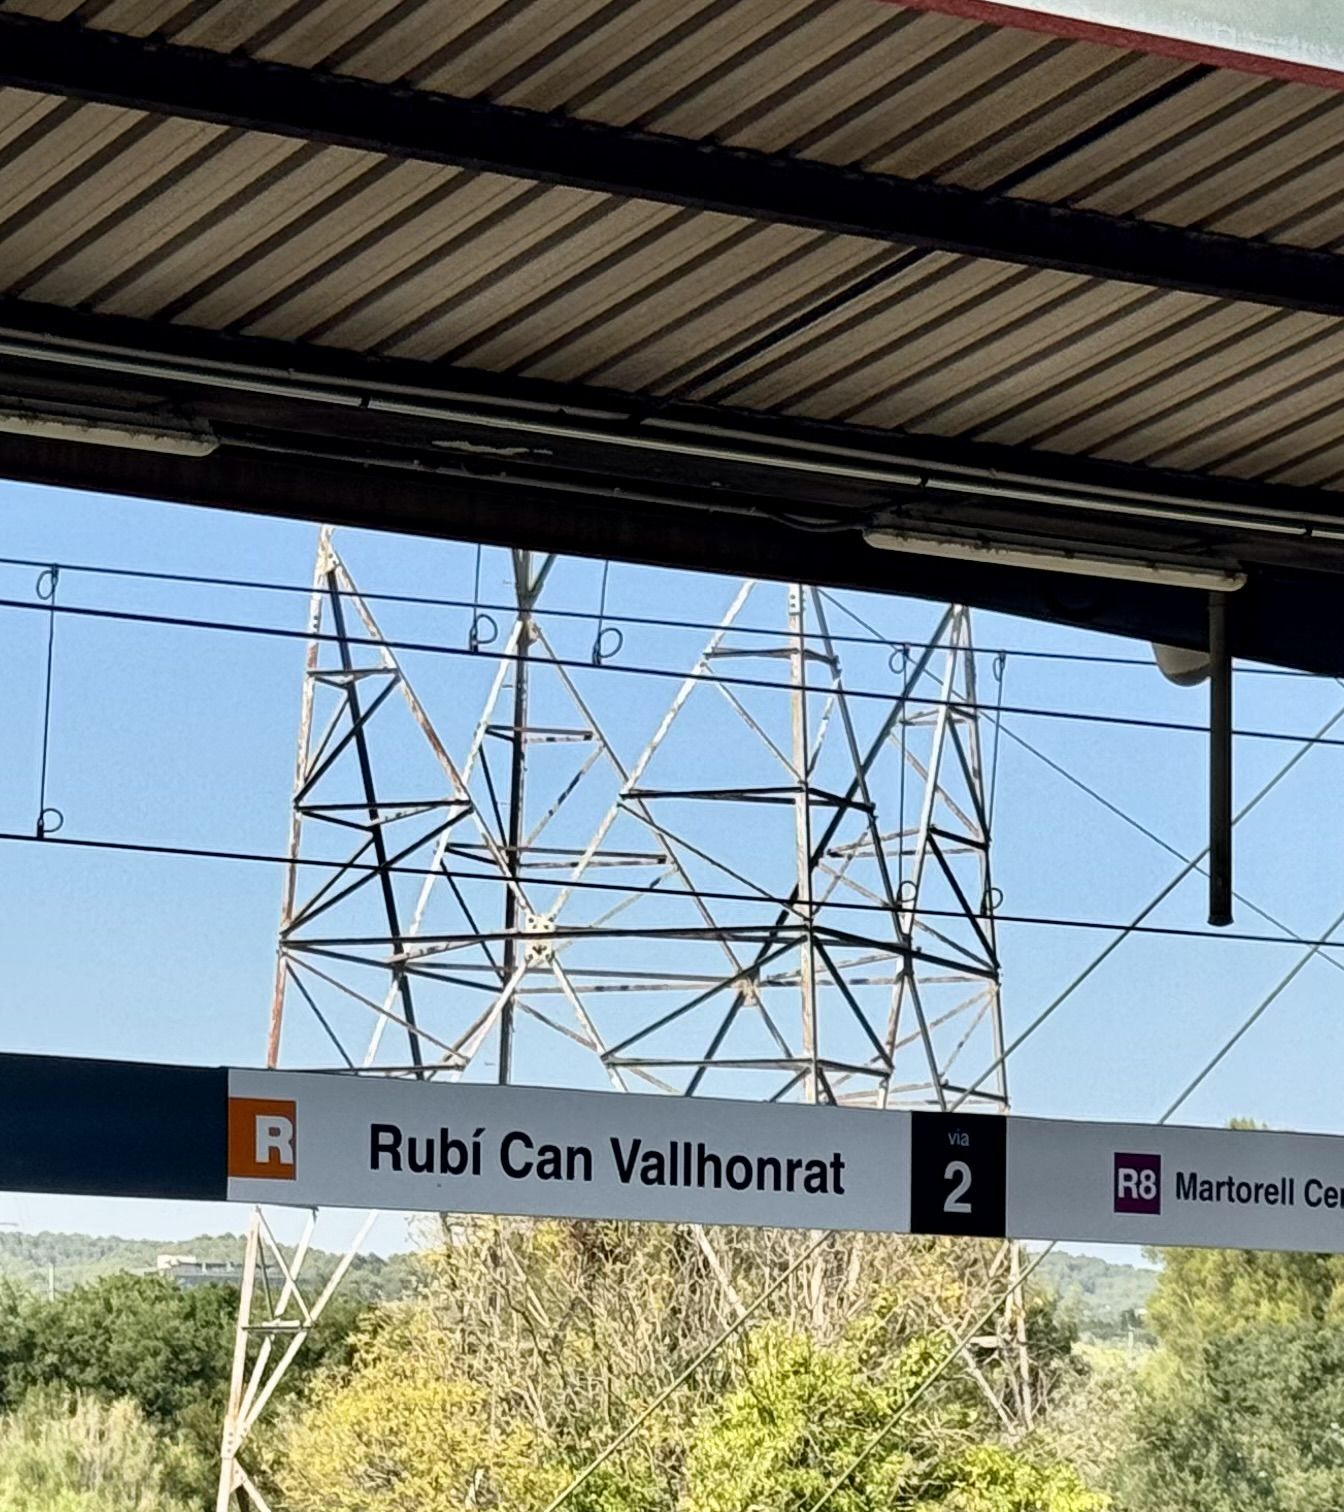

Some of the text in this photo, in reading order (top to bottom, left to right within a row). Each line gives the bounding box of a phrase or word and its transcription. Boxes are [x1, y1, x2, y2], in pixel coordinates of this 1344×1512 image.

[255, 1114, 294, 1165] R
[369, 1122, 846, 1195] Rubí Can Vallhonrat
[947, 1128, 970, 1147] via
[943, 1160, 973, 1214] 2
[1116, 1167, 1157, 1200] R8
[1175, 1171, 1295, 1206] Martorell
